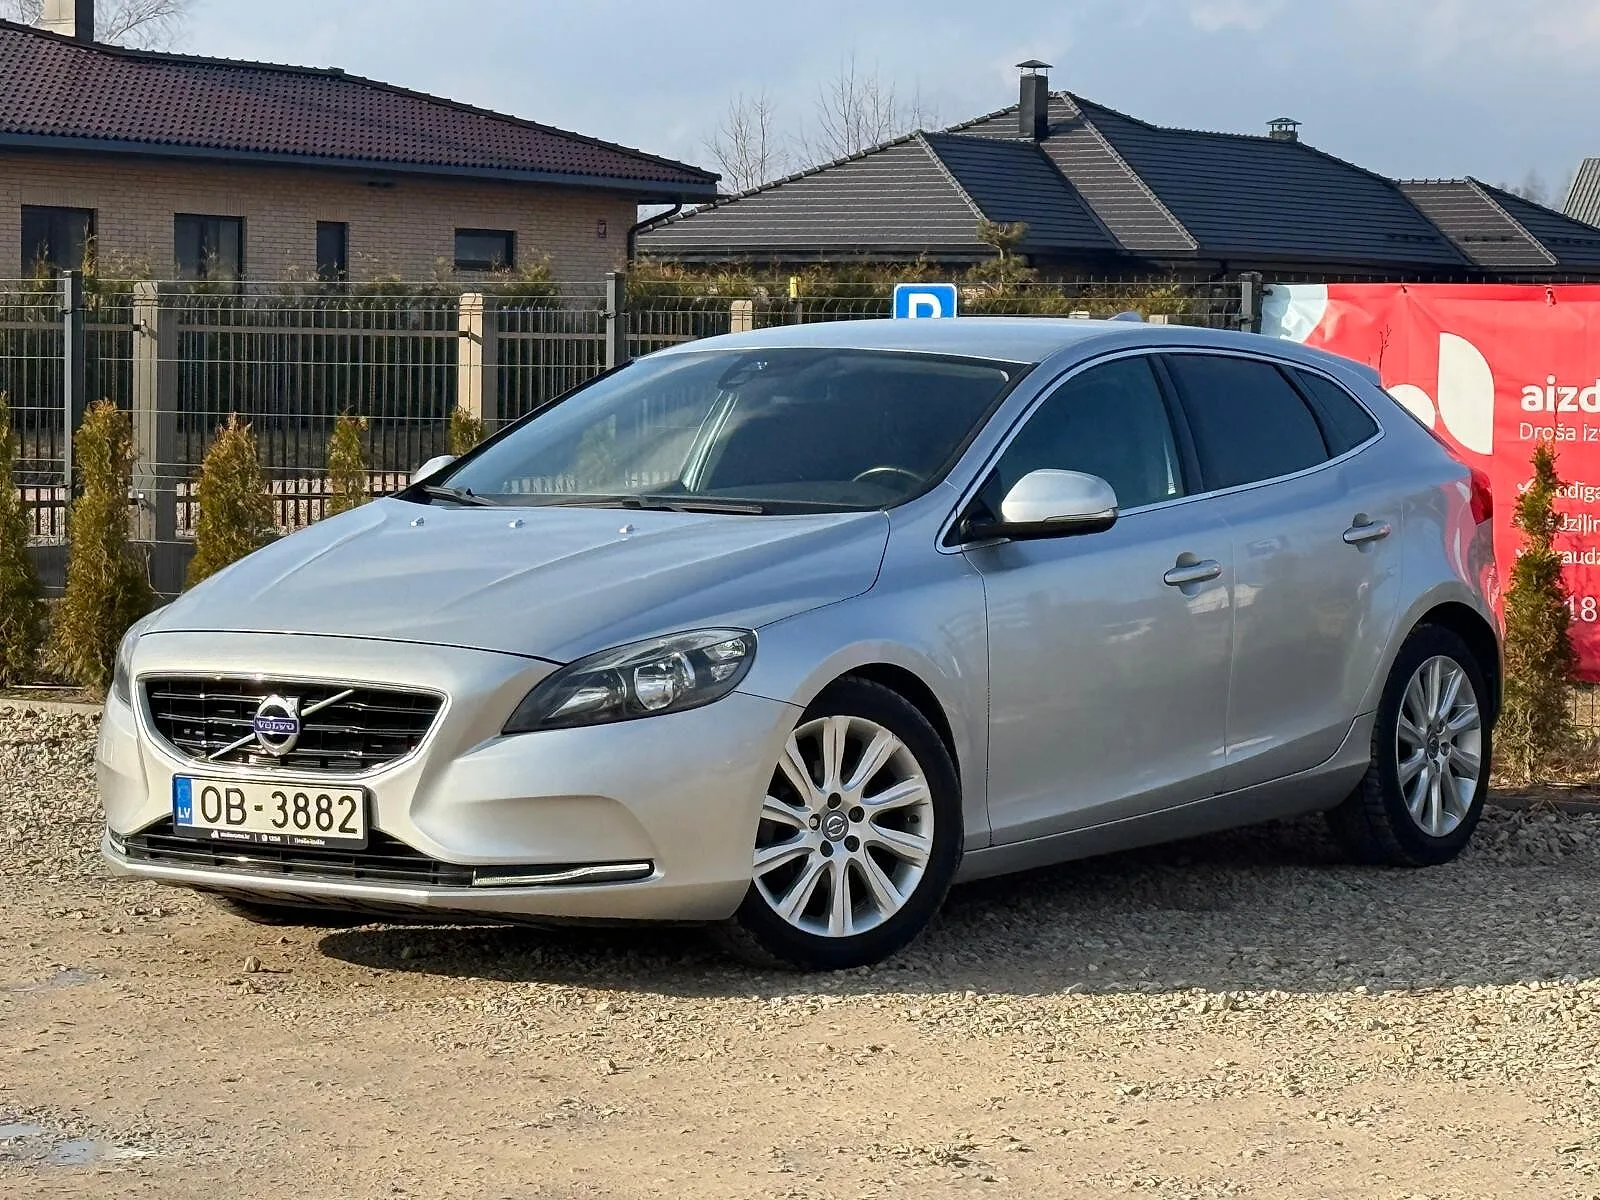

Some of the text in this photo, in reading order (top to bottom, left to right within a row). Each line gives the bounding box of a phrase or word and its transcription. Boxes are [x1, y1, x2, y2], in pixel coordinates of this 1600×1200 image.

[1520, 374, 1600, 413] aizd
[1519, 422, 1576, 440] Droša
[258, 720, 295, 730] VOLVO
[178, 806, 191, 818] LV
